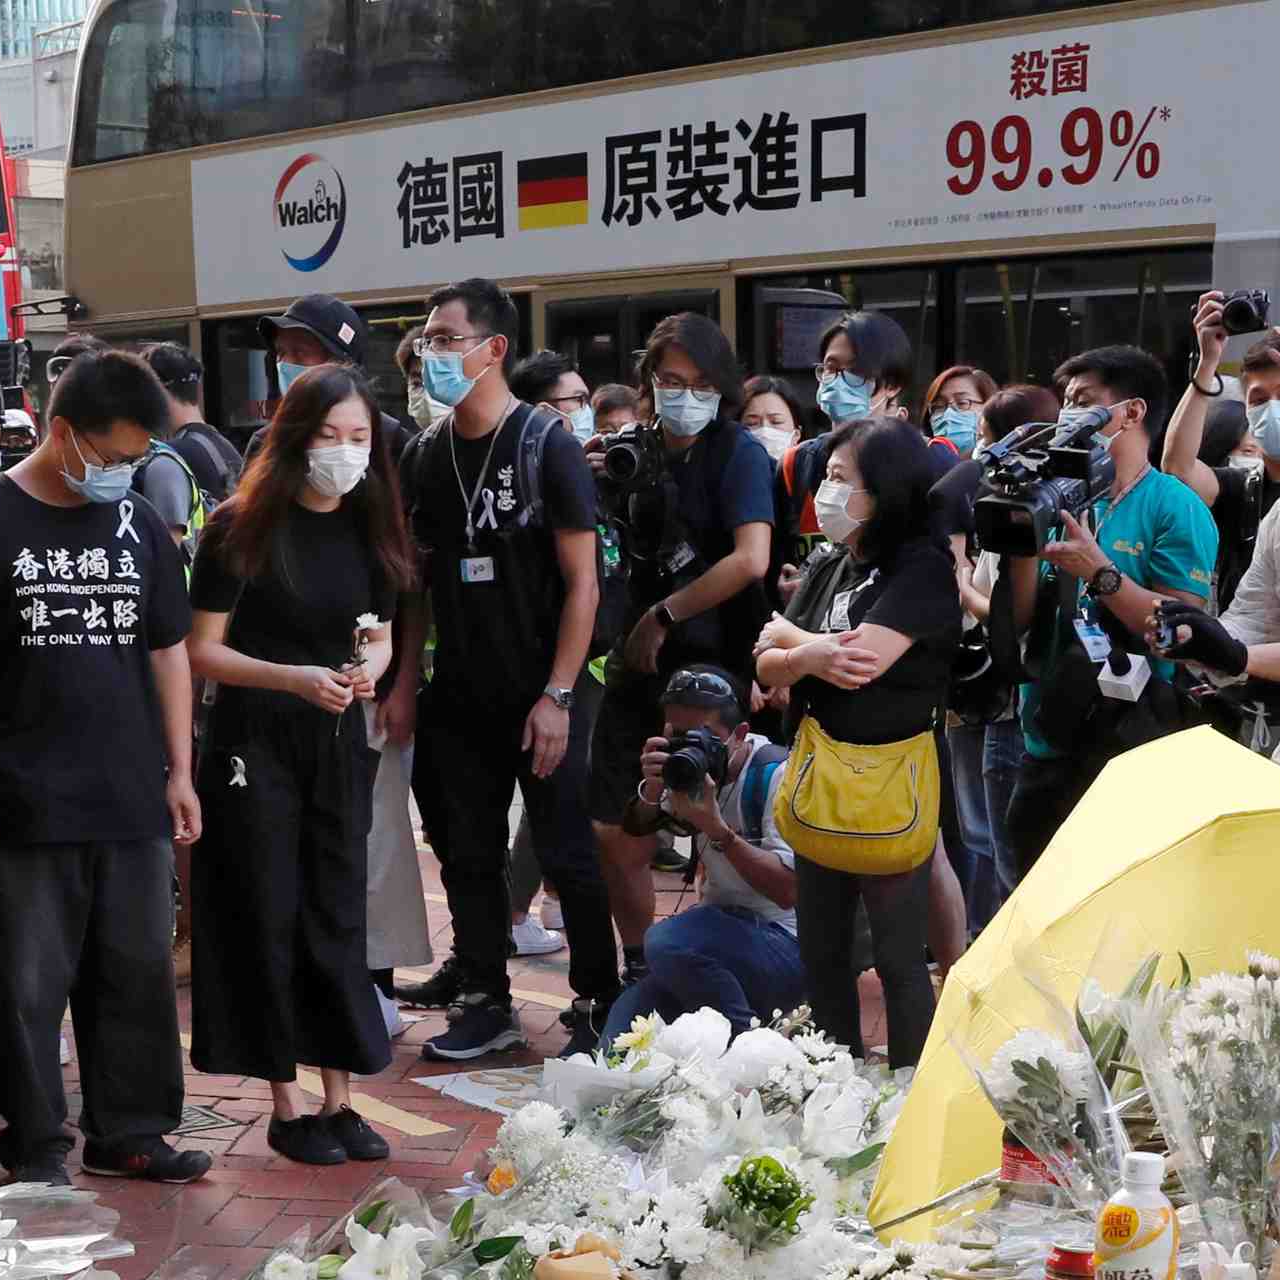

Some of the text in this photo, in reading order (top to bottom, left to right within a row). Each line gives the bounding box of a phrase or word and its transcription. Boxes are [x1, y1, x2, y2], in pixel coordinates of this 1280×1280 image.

[1009, 43, 1090, 101] 殺菌
[396, 111, 867, 250] 德國 原裝進口
[278, 196, 338, 227] Walch
[12, 547, 141, 581] 香港獨立
[16, 583, 141, 597] HONG KONG INDEPENDENCE
[20, 597, 139, 632] 唯一出路
[21, 634, 137, 646] THE ONLY WAY OUT
